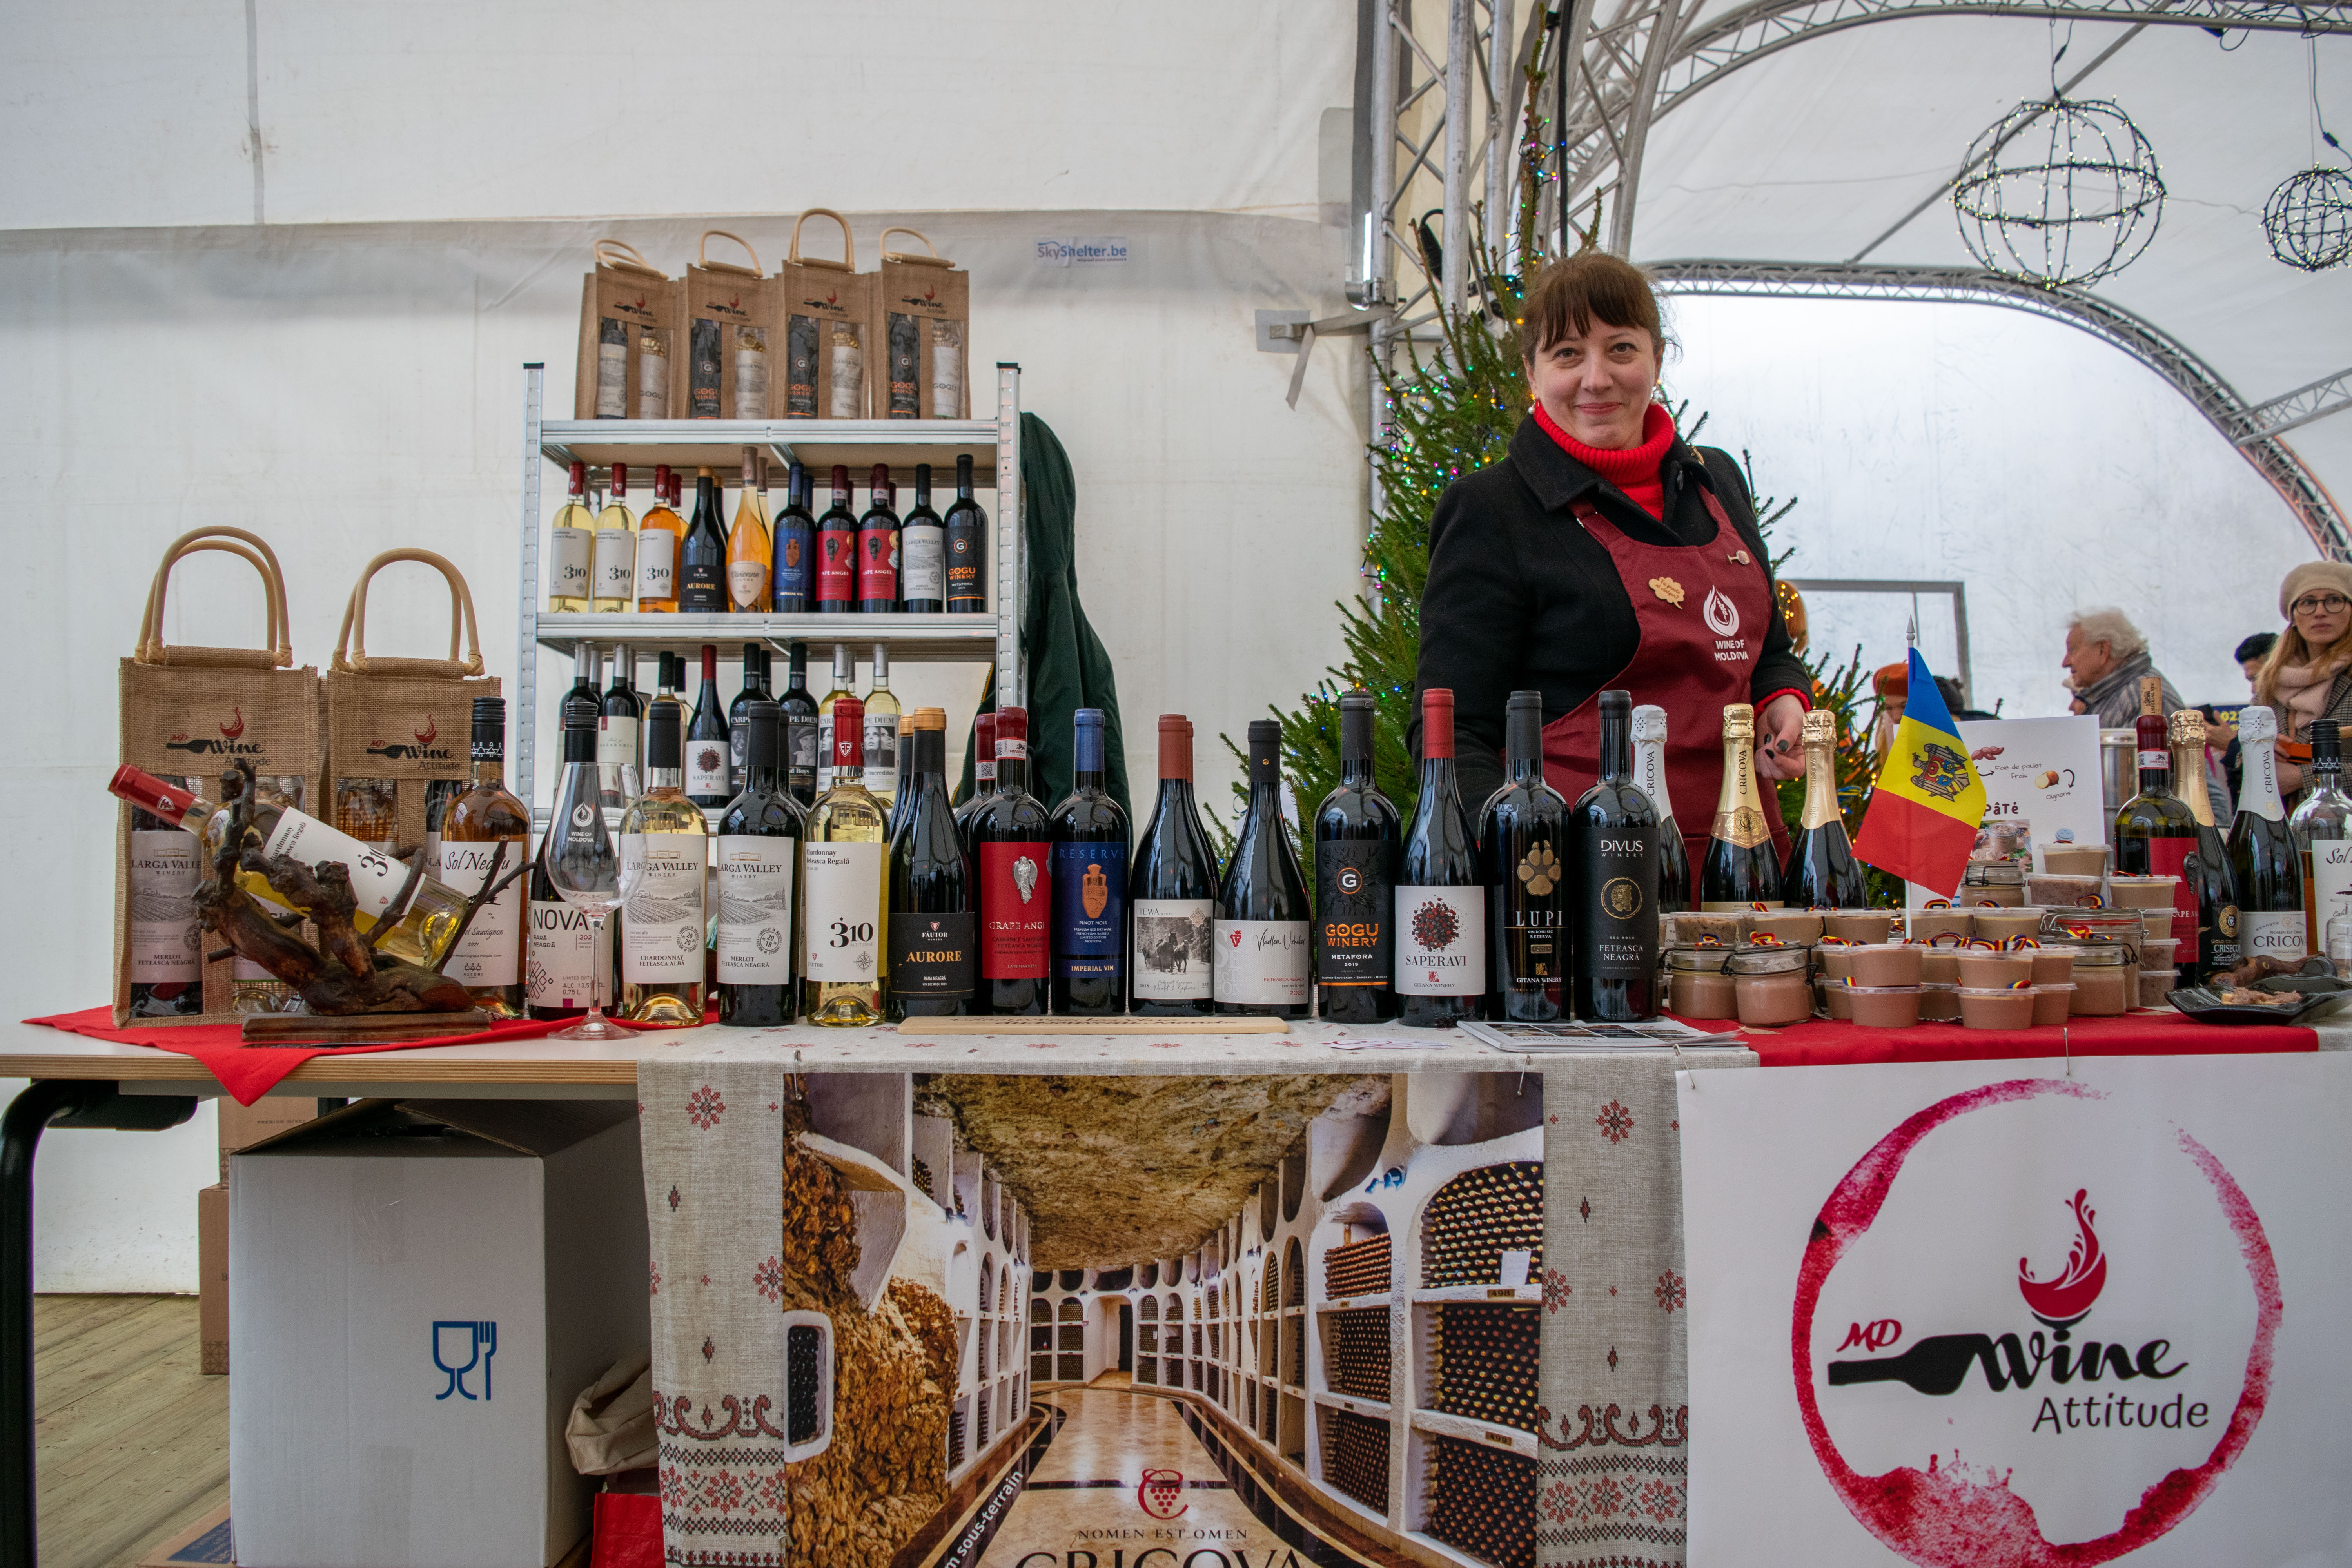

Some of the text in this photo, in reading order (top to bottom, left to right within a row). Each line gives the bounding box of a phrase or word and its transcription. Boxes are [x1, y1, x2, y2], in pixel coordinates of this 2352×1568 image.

[1038, 245, 1127, 260] SkyShelter.be
[704, 363, 712, 372] G
[797, 359, 806, 368] G
[901, 357, 909, 366] G
[933, 382, 956, 392] GOGU
[564, 565, 586, 579] 310
[609, 567, 630, 580] 310
[647, 567, 669, 580] 310
[948, 567, 976, 575] GOGU
[1715, 639, 1745, 650] WINE OF
[1714, 651, 1749, 661] MOLDOVA
[208, 738, 265, 754] Wine
[405, 745, 454, 759] Wine
[418, 761, 461, 770] Attitude
[2022, 762, 2042, 771] poulet
[1646, 750, 1655, 797] CRICOVA
[1739, 750, 1748, 795] CRICOVA
[2046, 791, 2071, 802] Oignons
[806, 848, 837, 857] Chardonnay
[1060, 848, 1125, 859] RESERVE
[2326, 847, 2348, 864] Sol
[132, 859, 169, 869] LARGA
[445, 849, 511, 880] Sol Negu
[662, 862, 699, 871] VALLEY
[718, 863, 782, 873] LARGA VALLEY
[1342, 874, 1357, 887] G
[1515, 910, 1563, 927] LUPI
[989, 922, 1021, 930] GRAPE
[1325, 923, 1378, 938] GOGU
[2255, 922, 2279, 931] RESERVE
[471, 927, 504, 940] Sauvignon
[829, 922, 874, 948] 310
[1327, 937, 1378, 948] WINERY
[1599, 944, 1644, 952] FETEASCA
[906, 951, 962, 962] AURORE
[1406, 955, 1467, 967] SAPERAVI
[1836, 1318, 1902, 1352] MD
[1976, 1329, 2189, 1393] Wine
[2032, 1392, 2210, 1435] Attitude
[957, 1471, 1024, 1557] sous-terrain
[1078, 1528, 1248, 1540] NOMEN EST OMEN
